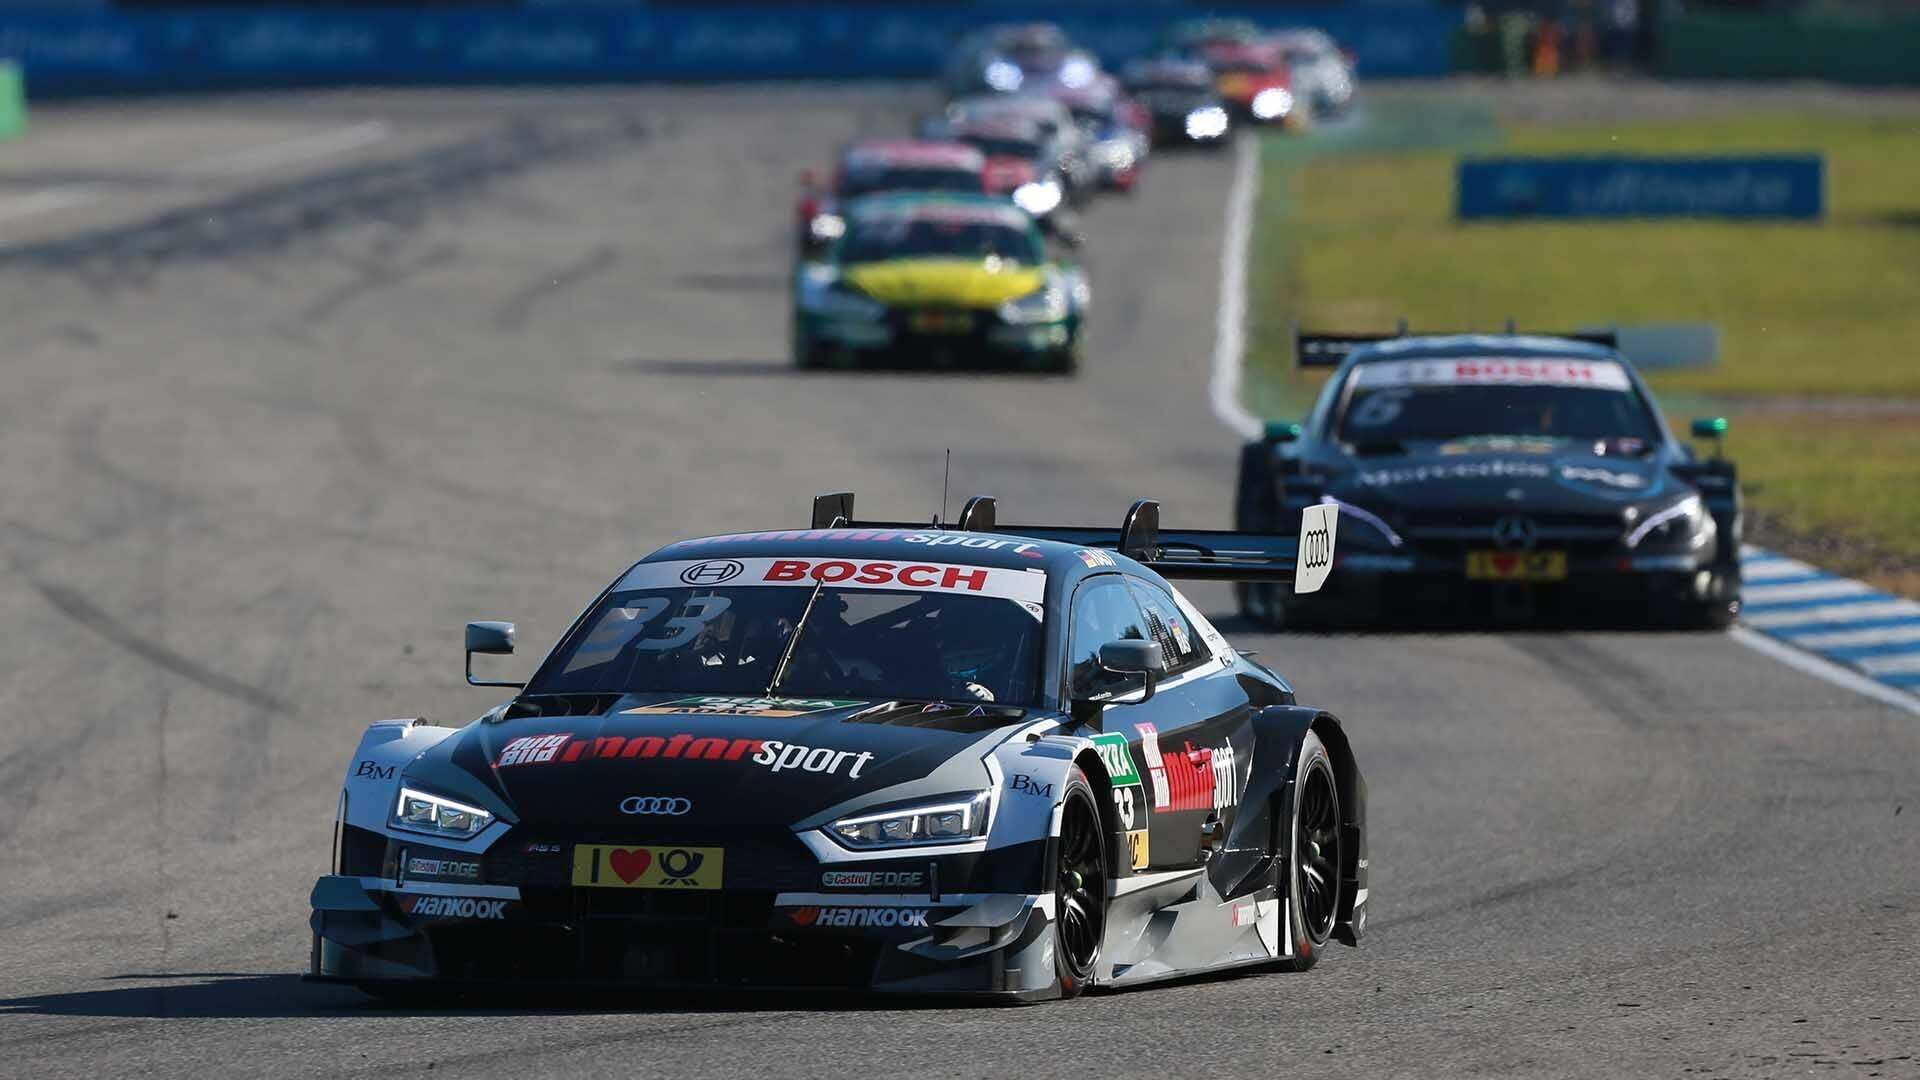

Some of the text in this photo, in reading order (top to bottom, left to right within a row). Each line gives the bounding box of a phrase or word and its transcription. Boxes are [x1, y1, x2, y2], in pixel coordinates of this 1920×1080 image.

[1455, 359, 1595, 380] BOSCH
[763, 560, 988, 591] BOSCH
[440, 860, 480, 878] EDGE
[870, 871, 924, 886] EDGE
